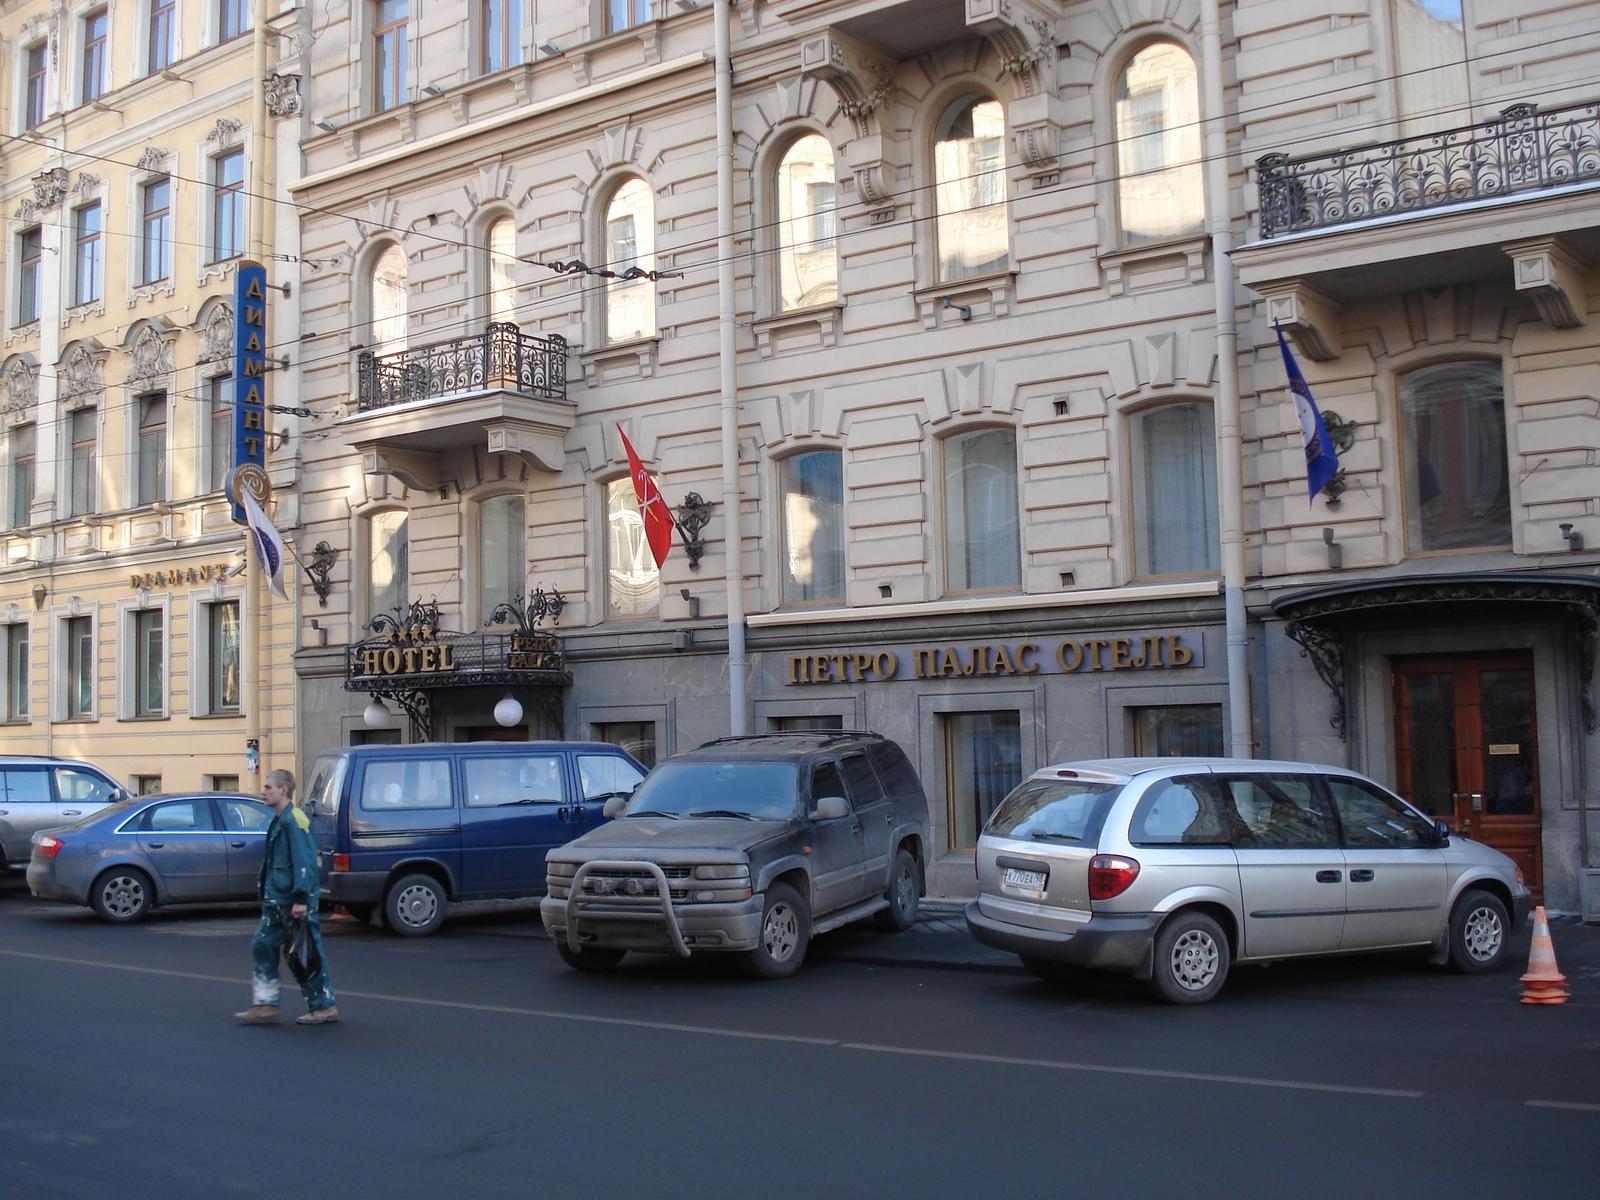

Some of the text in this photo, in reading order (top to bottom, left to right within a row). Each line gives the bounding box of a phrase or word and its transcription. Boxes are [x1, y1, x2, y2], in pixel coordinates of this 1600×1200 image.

[243, 276, 264, 457] ДИАМАНТ
[130, 563, 228, 589] DIAMANT
[512, 636, 559, 652] PETRO
[787, 635, 1193, 683] ПЕТРО ПАЛАС ОТЕЛЬ
[363, 645, 455, 675] HOTEL
